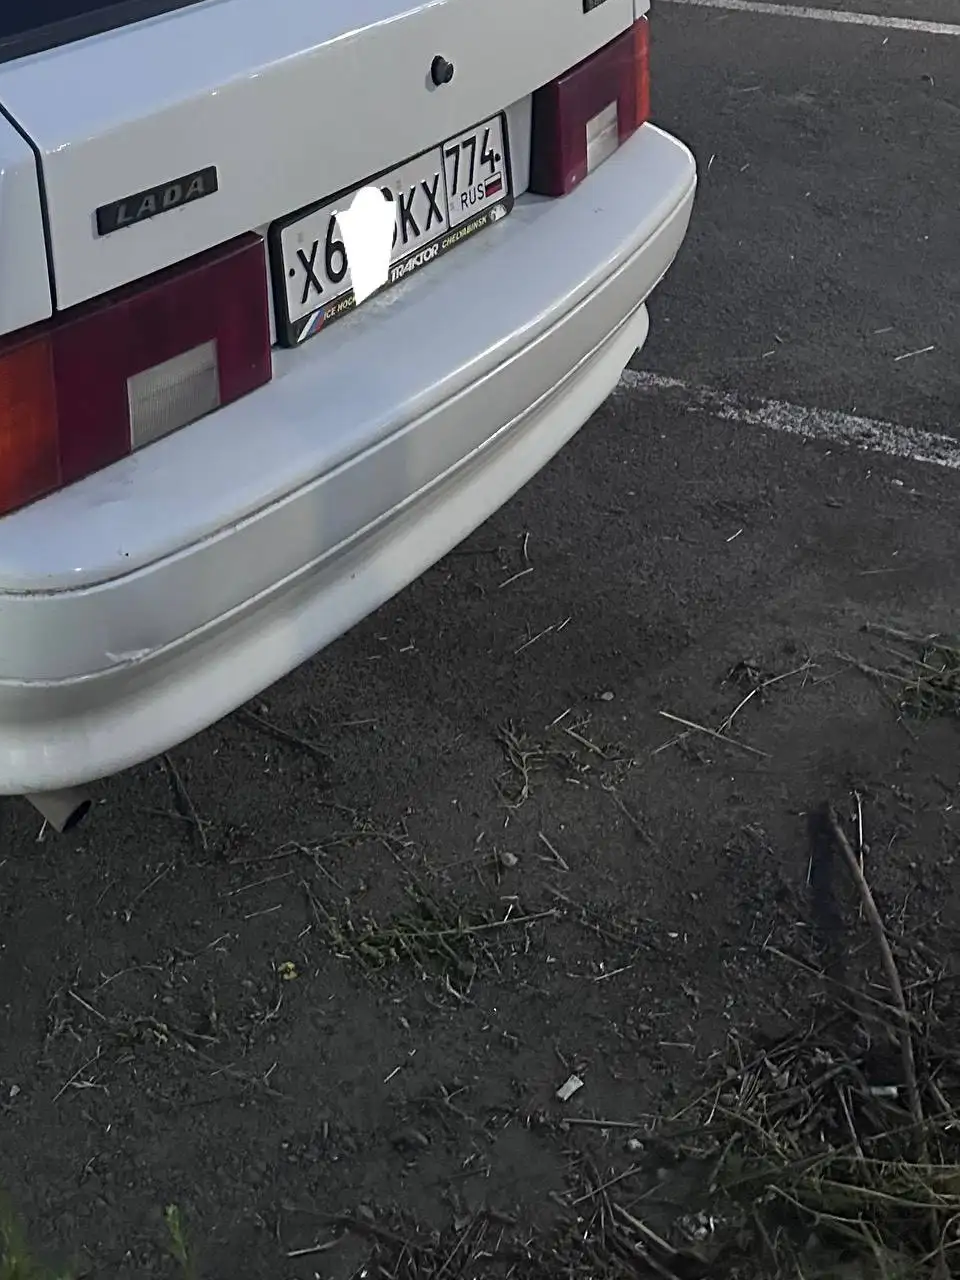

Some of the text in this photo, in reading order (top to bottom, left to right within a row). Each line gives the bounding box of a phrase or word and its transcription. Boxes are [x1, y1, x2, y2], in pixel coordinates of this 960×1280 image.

[445, 127, 497, 196] 774
[116, 175, 205, 224] LADA
[461, 183, 485, 211] RUS
[390, 243, 439, 282] TRAKTOR
